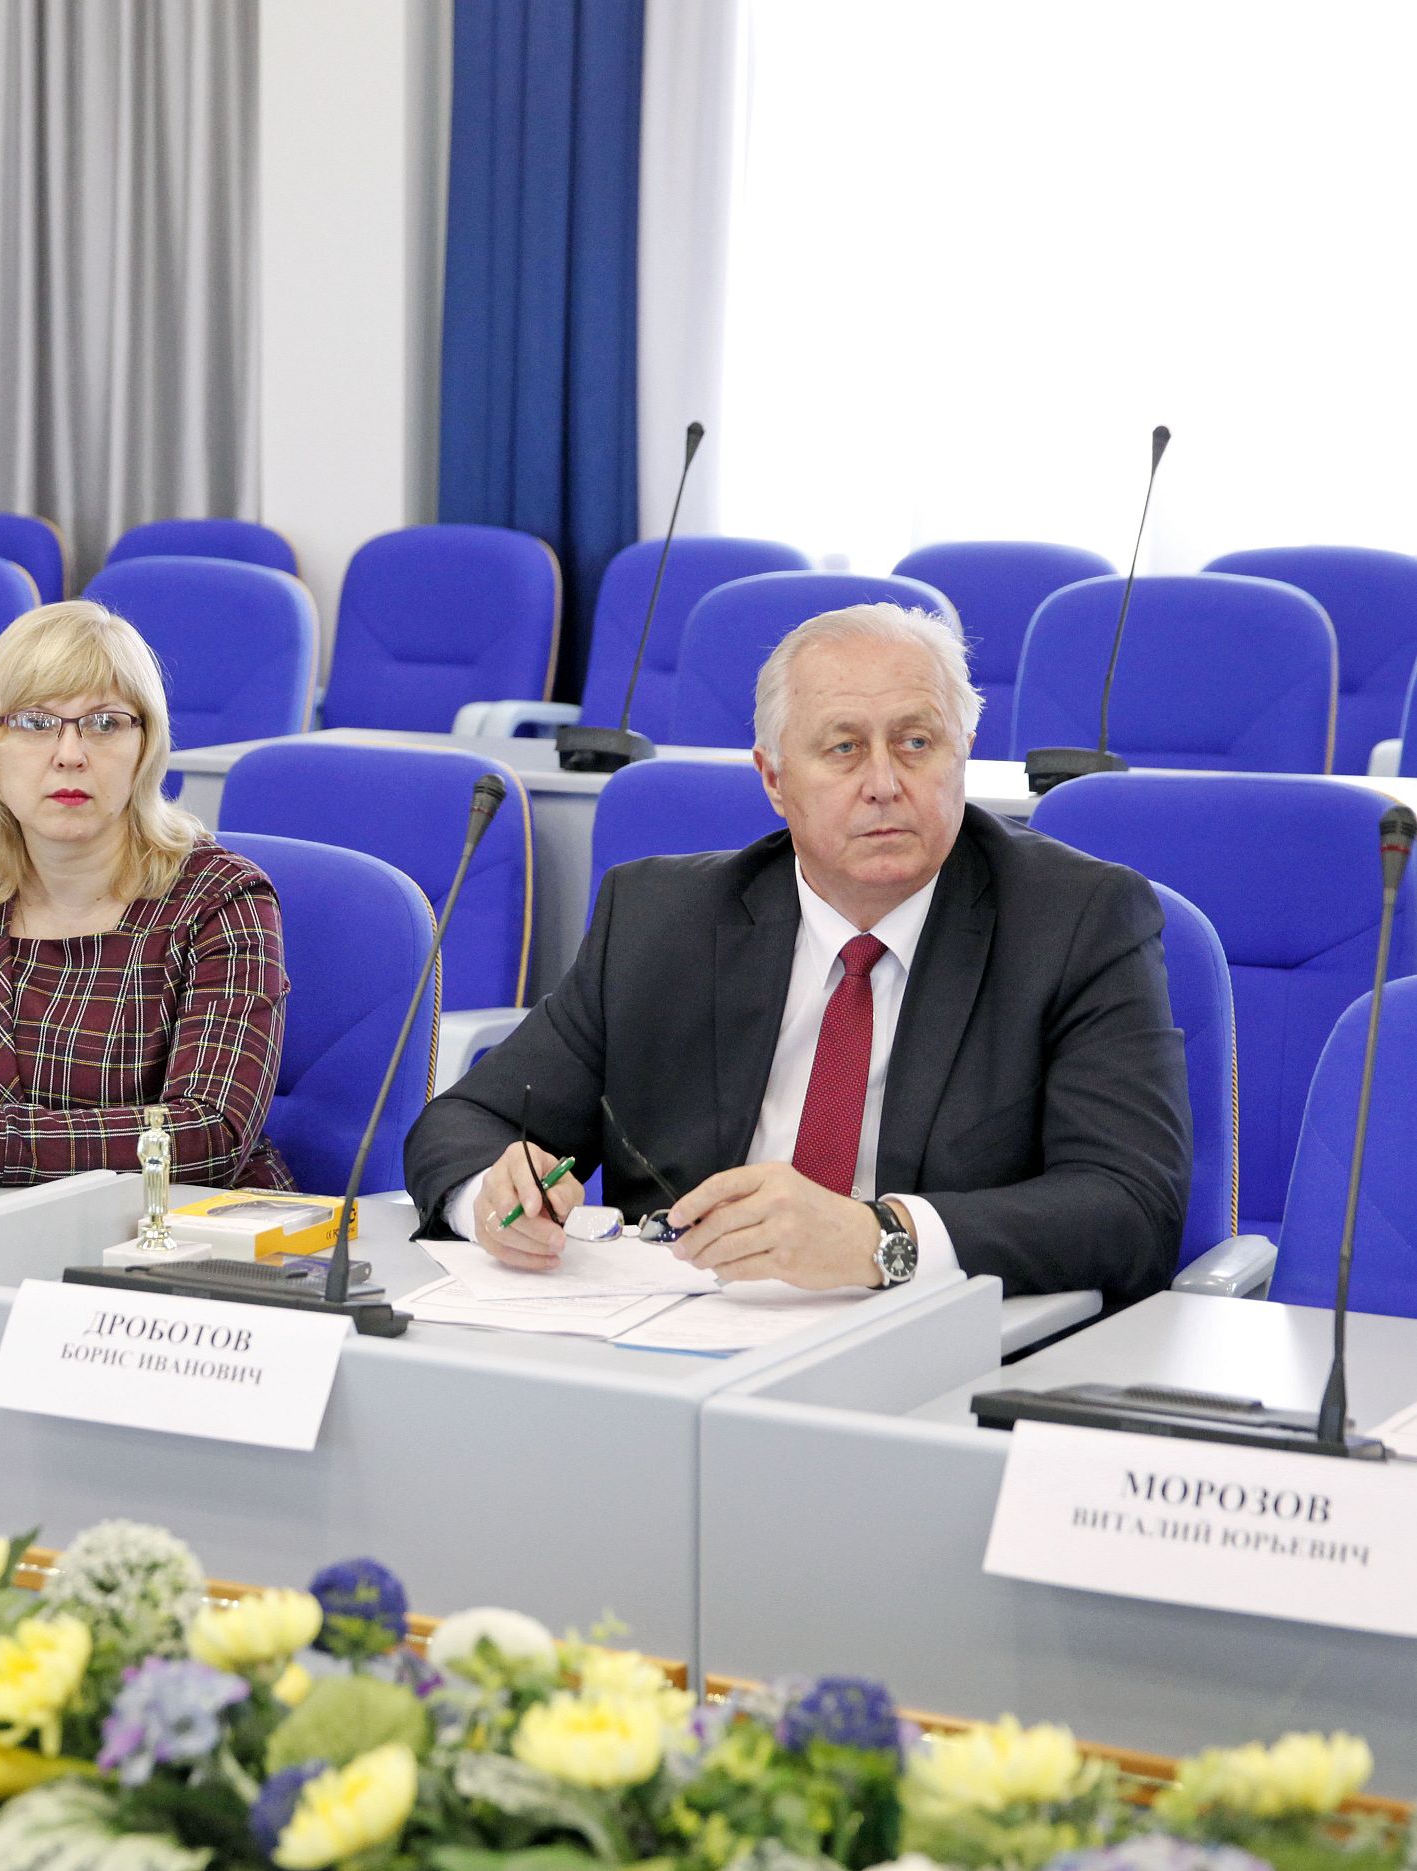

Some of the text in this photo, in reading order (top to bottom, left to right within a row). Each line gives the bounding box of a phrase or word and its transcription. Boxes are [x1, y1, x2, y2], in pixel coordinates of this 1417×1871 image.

[83, 1311, 253, 1353] ДРОБОТОВ
[60, 1342, 264, 1386] БОРИС ИВАНОВИЧ
[1122, 1469, 1332, 1523] МОРОЗОВ
[1072, 1507, 1371, 1566] ВИТАЛИЙ ЮРЬЕВИЧ
